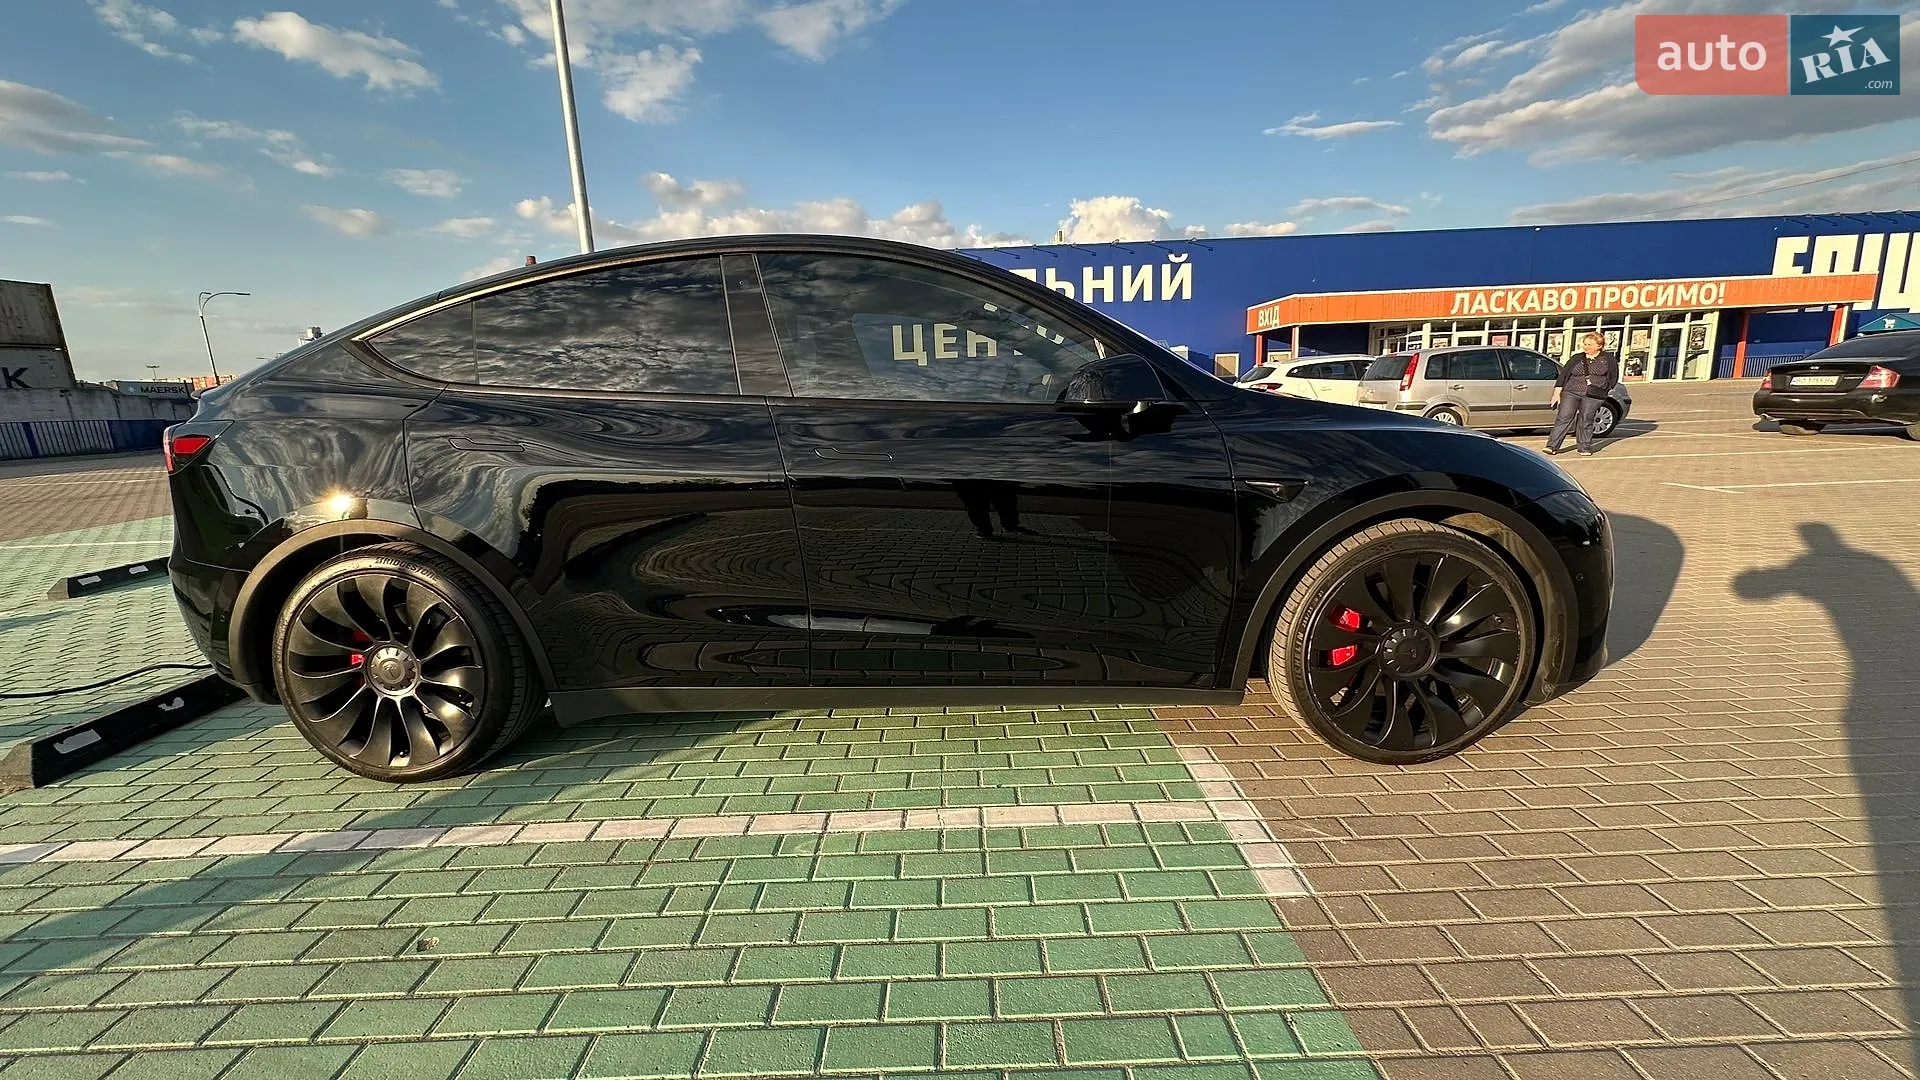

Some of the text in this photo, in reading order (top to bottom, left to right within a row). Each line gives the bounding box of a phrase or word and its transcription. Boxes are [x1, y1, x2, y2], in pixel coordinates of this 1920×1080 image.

[1009, 253, 1192, 304] ЬНИЙ
[1450, 282, 1726, 315] ЛАСКАВО ПРОСИМО!
[1257, 305, 1280, 328] ВХІД
[140, 386, 186, 395] MAERSK
[374, 557, 440, 582] BRIDGESTONE
